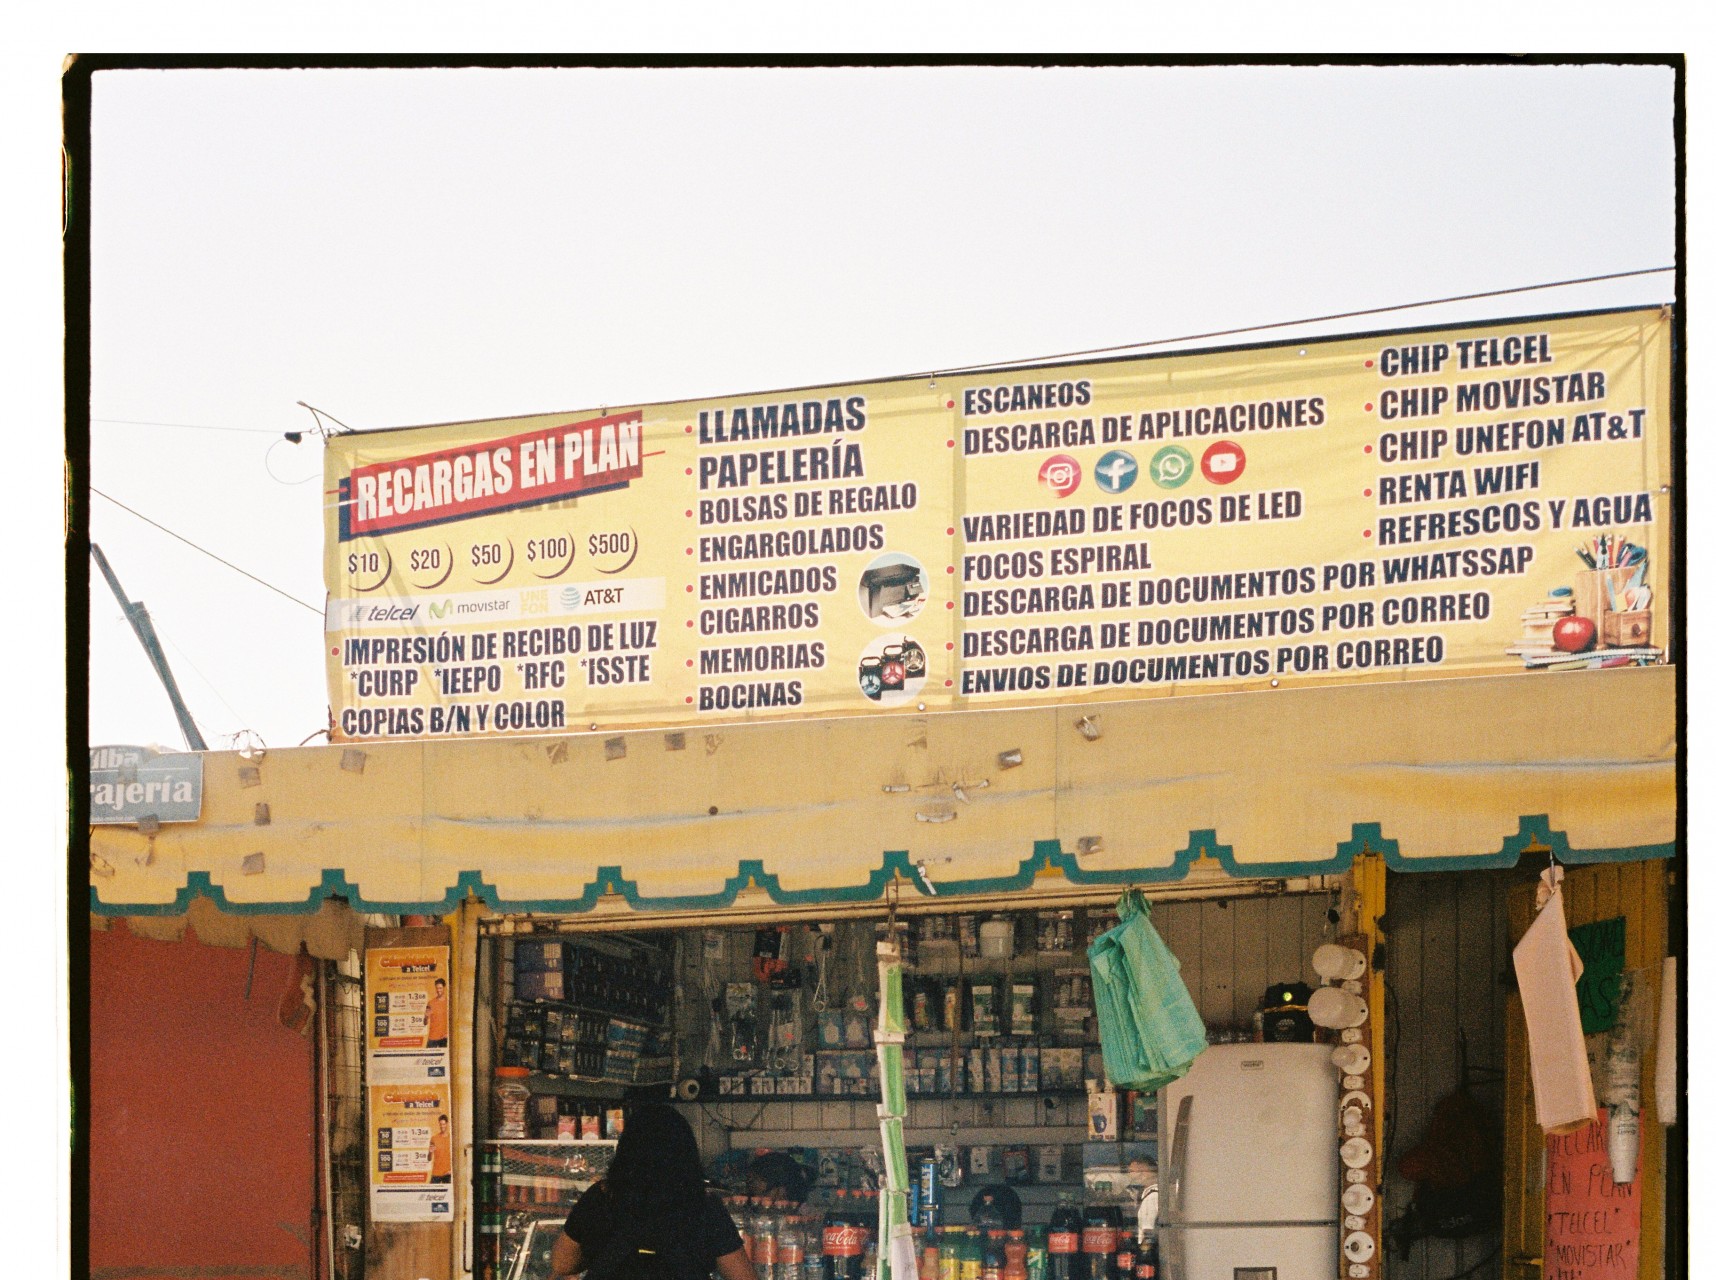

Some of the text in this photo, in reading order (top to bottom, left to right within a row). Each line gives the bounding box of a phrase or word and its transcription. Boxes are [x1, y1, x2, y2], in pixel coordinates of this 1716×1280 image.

[1380, 334, 1552, 377] CHIP TELCEL
[964, 381, 1091, 416] ESCANEOS
[1380, 371, 1606, 420] CHIP MOVISTAR
[699, 397, 866, 444] LLAMADAS
[964, 398, 1325, 456] DESCARGA DE APLICACIONES
[1379, 409, 1646, 463] CHIP UNEFON AT&T
[357, 420, 640, 521] RECARGAS EN PLAN
[699, 438, 864, 490] PAPELERÍA
[1379, 461, 1540, 505] RENTA WIFI
[699, 483, 917, 525] BOLSAS DE REGALO
[963, 490, 1302, 543] VARIEDAD DE FOCOS DE LED
[1378, 493, 1653, 546] REFRESCOS Y AGUA
[348, 532, 630, 573] $10 $20 $50 $100 $500
[699, 524, 884, 563] ENGARGOLADOS
[964, 543, 1152, 582] FOCOS ESPIRAL
[584, 587, 624, 606] AT&T
[699, 566, 837, 600] ENMICADOS
[964, 546, 1534, 617] DESCARGA DE DOCUMENTOS POR WHATSSAP
[368, 604, 420, 621] telcel
[458, 599, 511, 614] movistar
[700, 603, 819, 635] CIGARROS
[963, 592, 1490, 658] DESCARGA DE DOCUMENTOS POR CORREO
[344, 620, 658, 666] IMPRESIÓN DE RECIBO DE LUZ
[700, 642, 825, 675] MEMORIAS
[962, 635, 1444, 695] ENVIOS DE DOCUMENTOS POR CORREO
[342, 699, 566, 736] COPIAS B/N Y COLOR
[699, 681, 802, 711] BOCINAS
